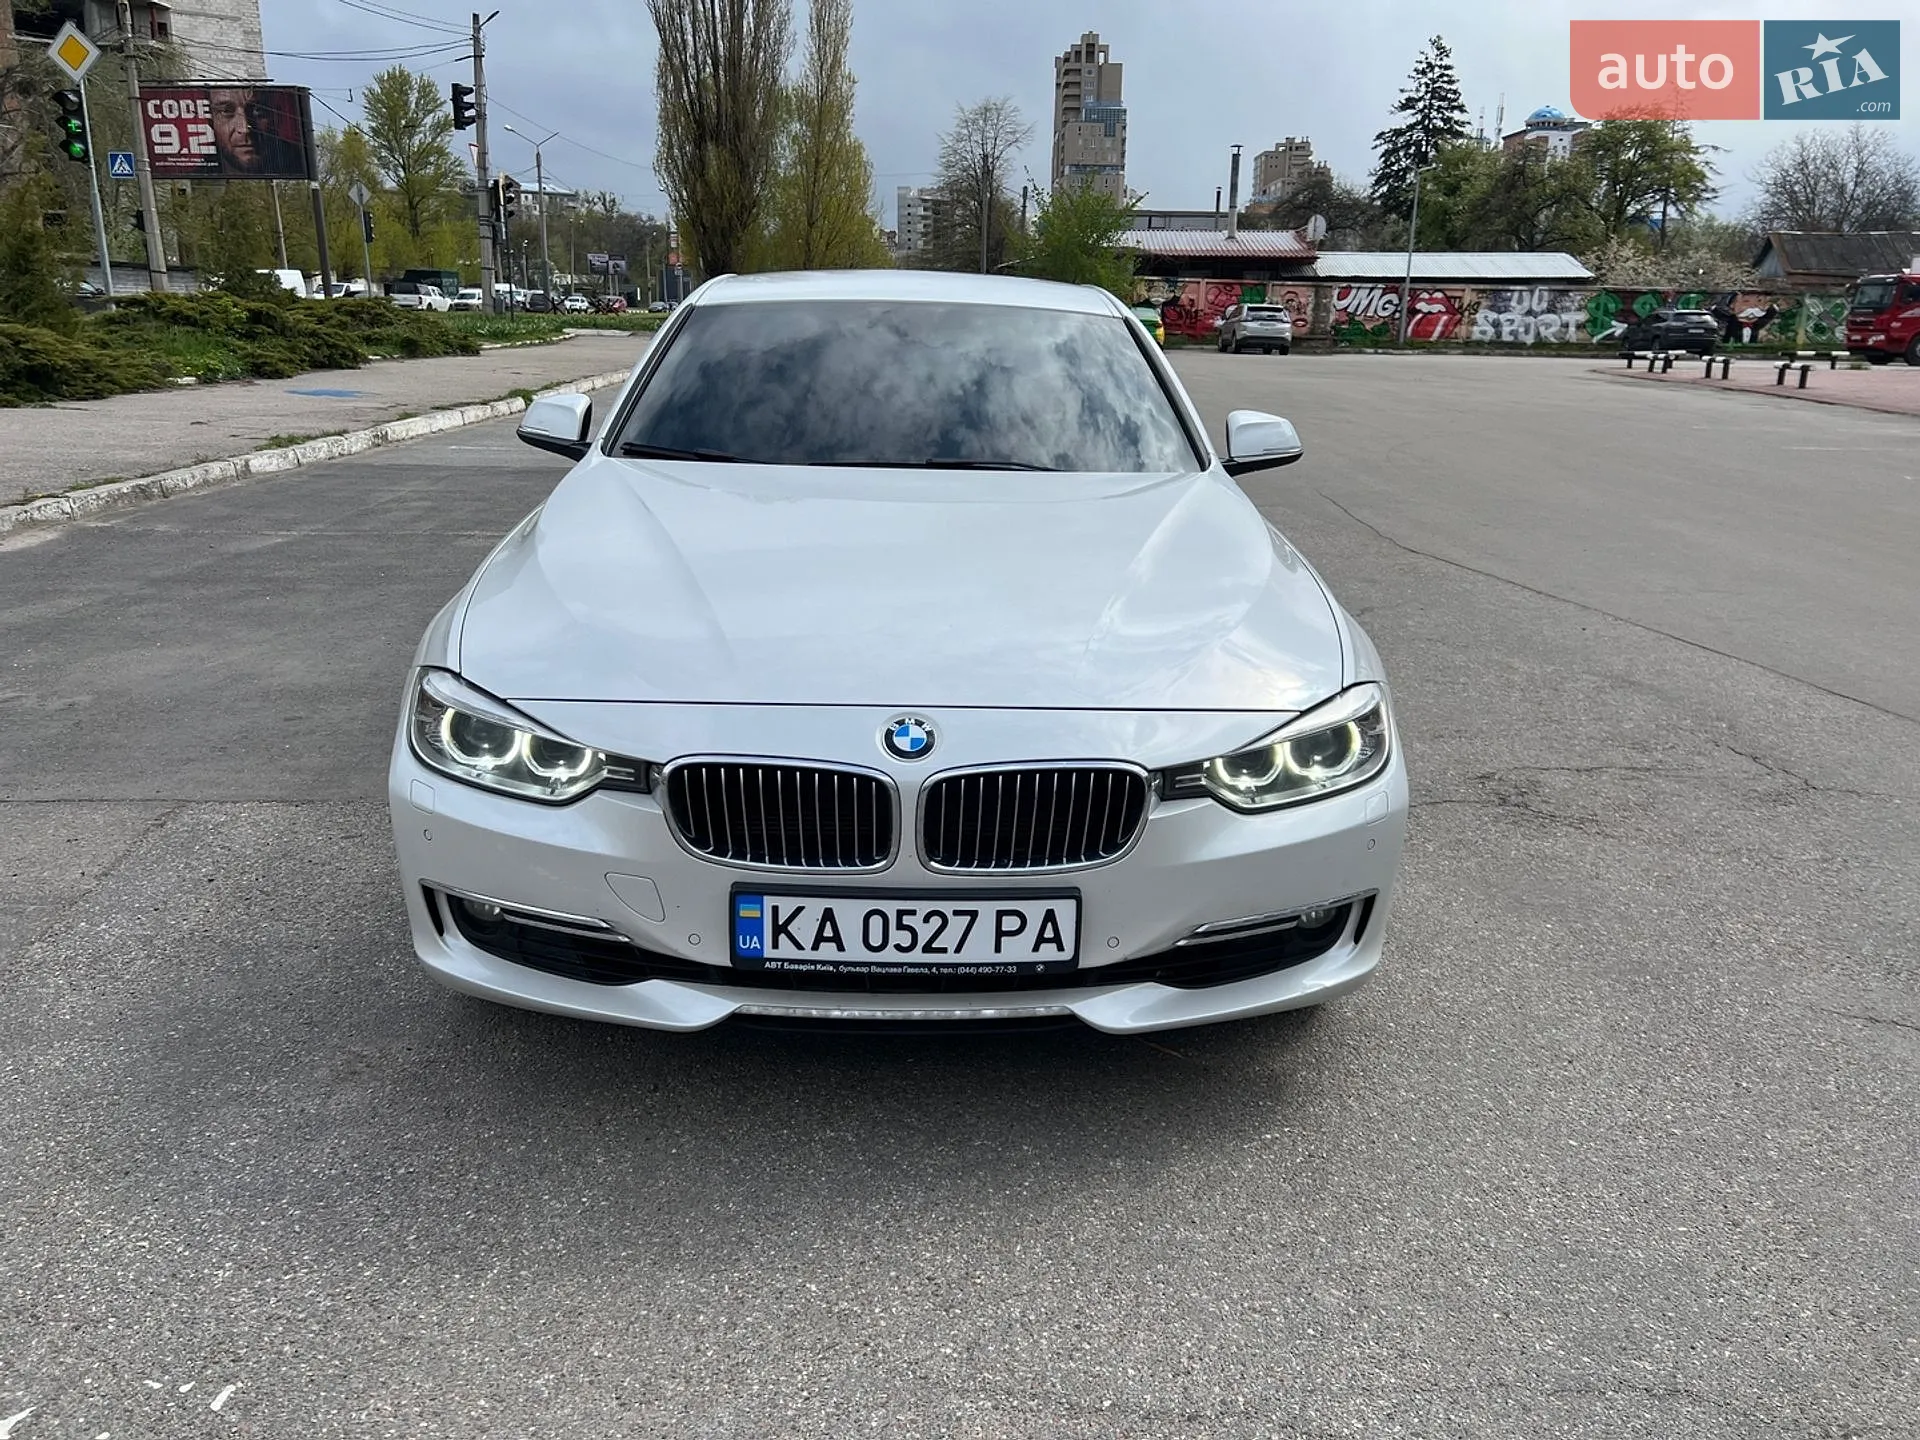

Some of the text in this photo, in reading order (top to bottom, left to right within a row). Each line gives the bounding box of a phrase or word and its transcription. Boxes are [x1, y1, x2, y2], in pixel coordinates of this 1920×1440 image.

[147, 99, 212, 119] CODE
[150, 123, 217, 155] 9.2
[771, 904, 1065, 954] KA 0527 PA
[739, 935, 761, 949] UA
[978, 965, 1017, 974] 490-77-33
